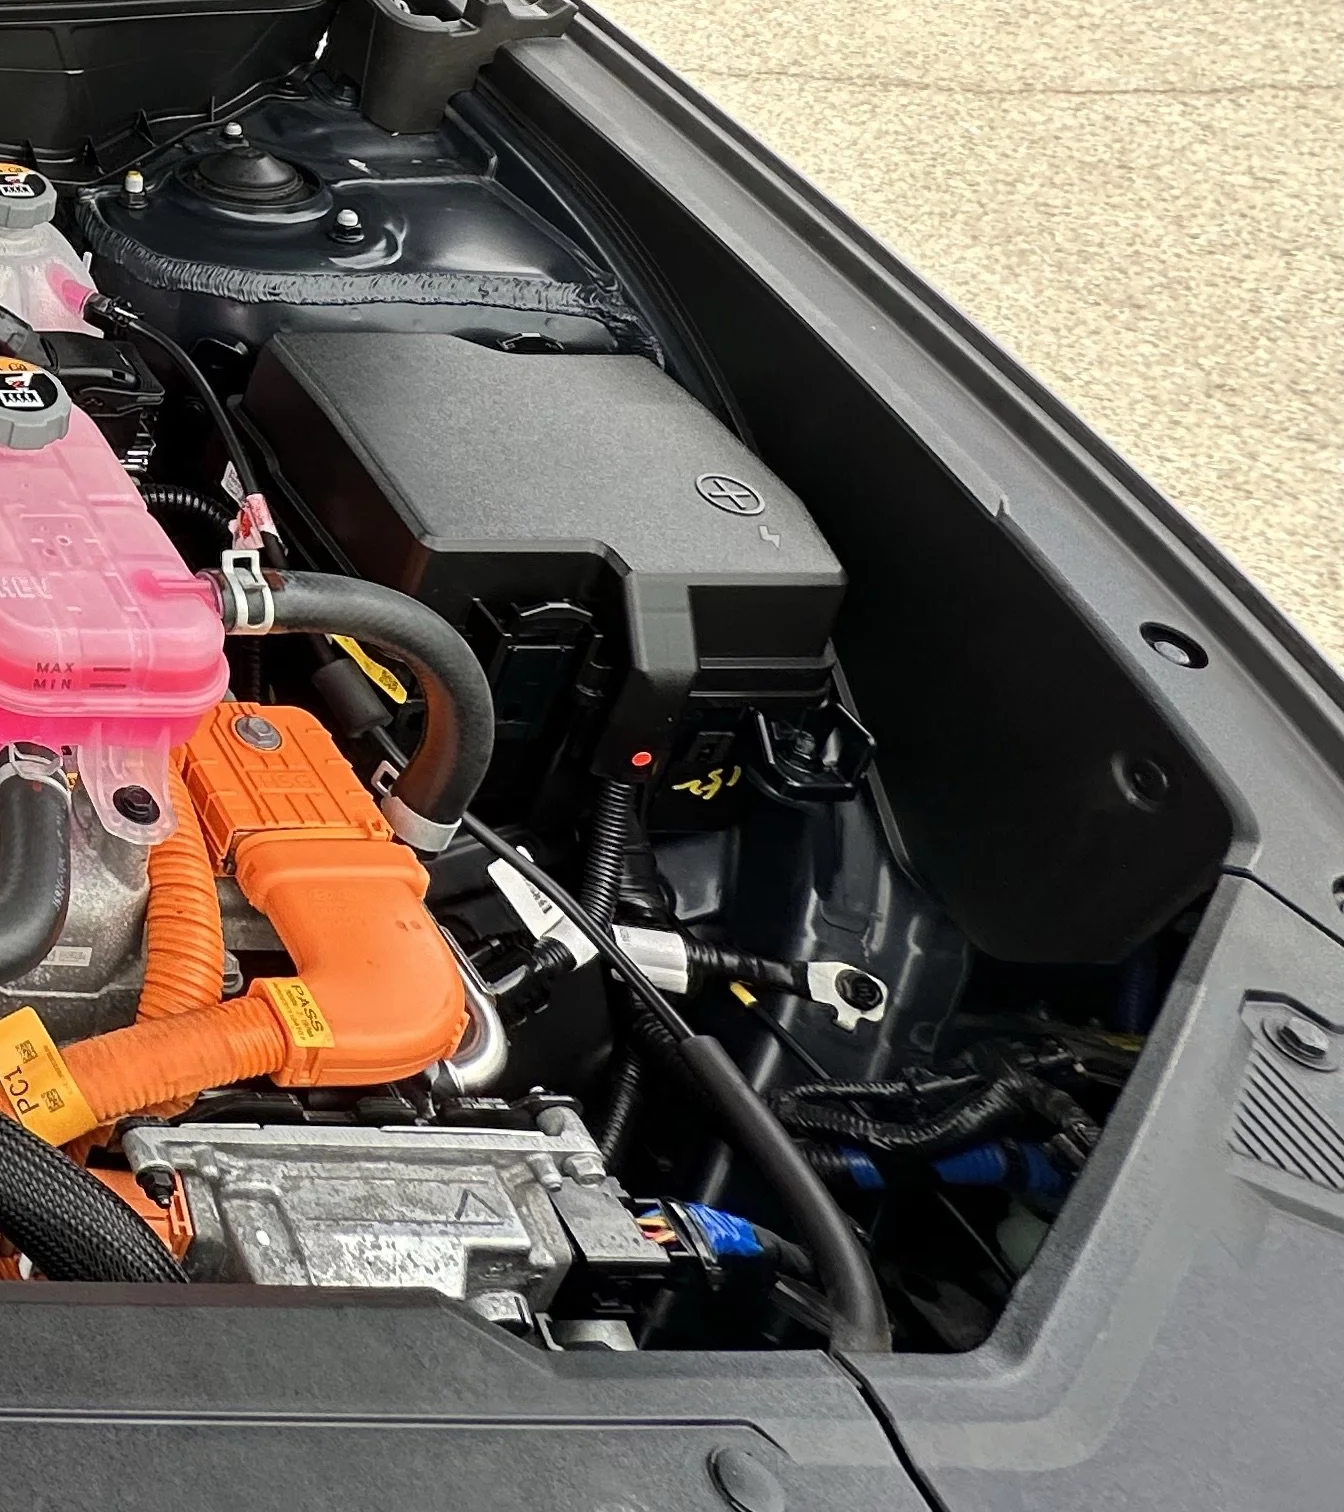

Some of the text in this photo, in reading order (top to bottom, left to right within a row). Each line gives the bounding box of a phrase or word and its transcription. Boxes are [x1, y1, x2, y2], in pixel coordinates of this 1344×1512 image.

[36, 662, 74, 674] MAX
[33, 678, 72, 690] MIN
[291, 984, 325, 1032] PASS
[3, 1065, 40, 1115] PC1
